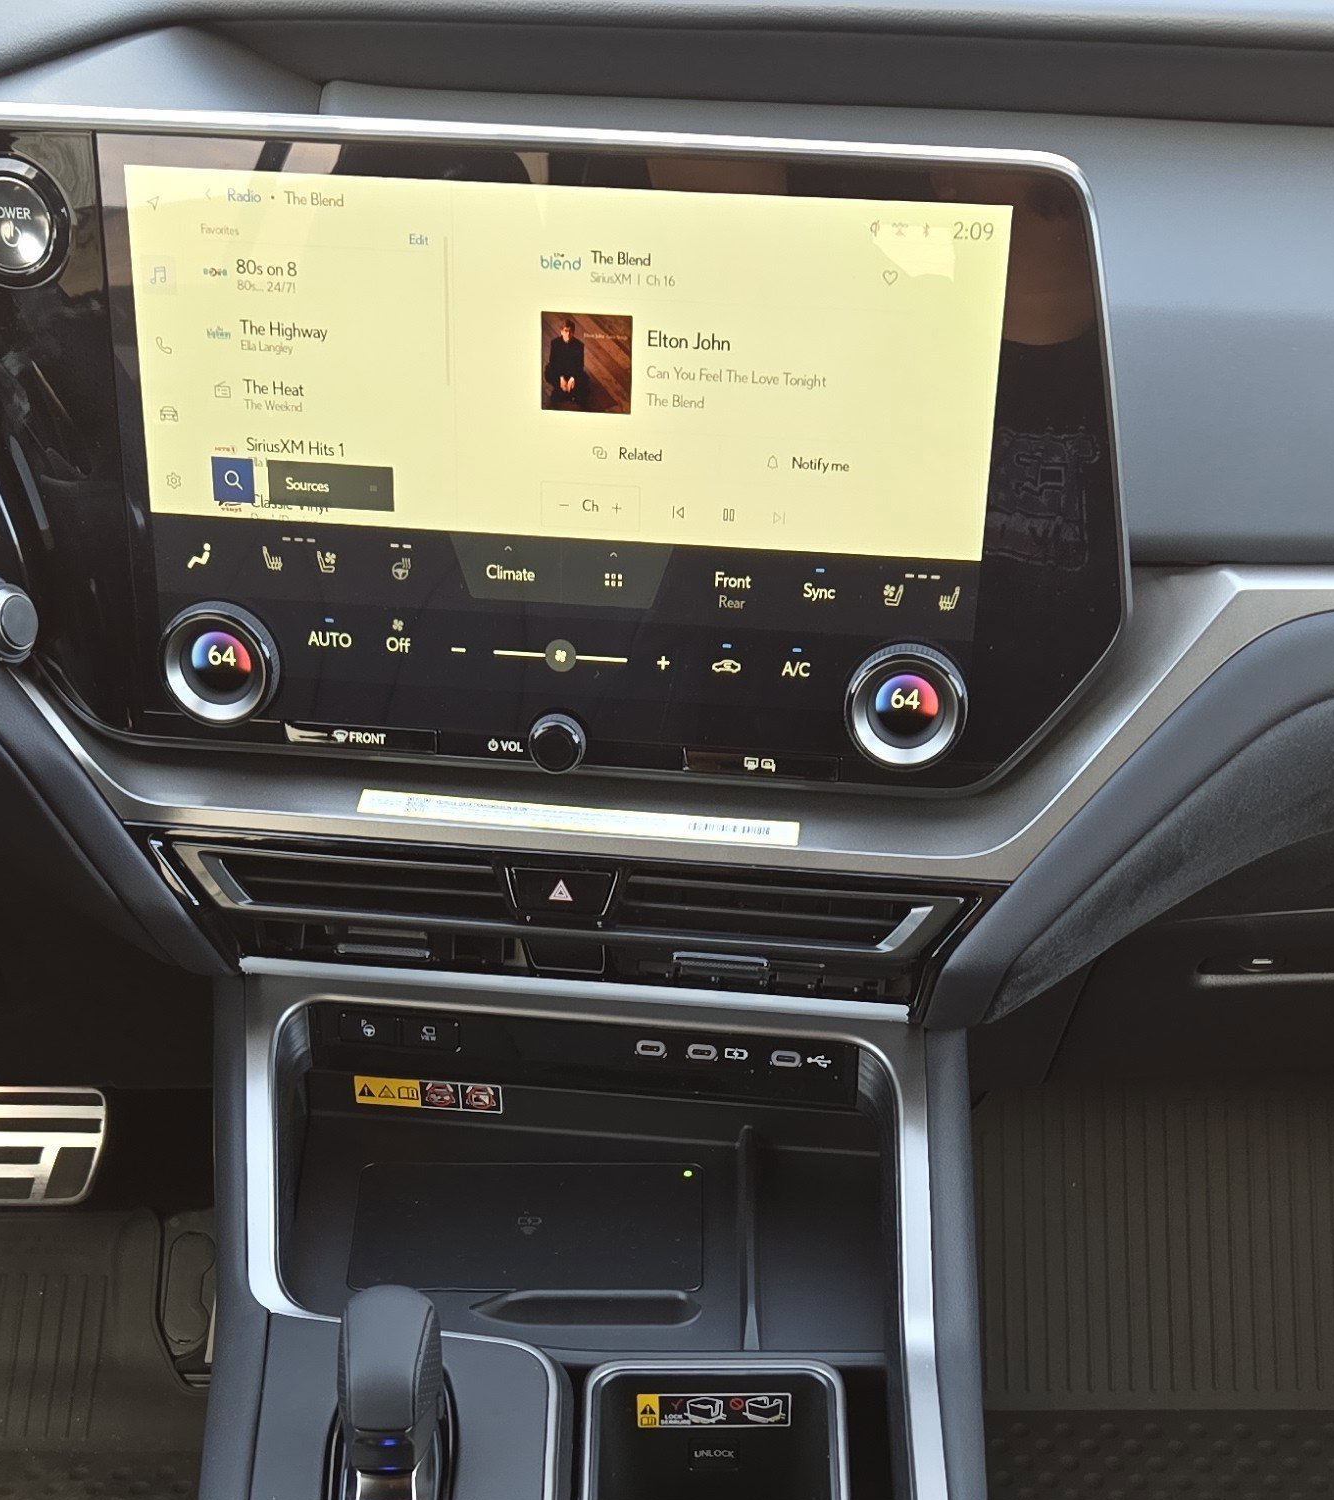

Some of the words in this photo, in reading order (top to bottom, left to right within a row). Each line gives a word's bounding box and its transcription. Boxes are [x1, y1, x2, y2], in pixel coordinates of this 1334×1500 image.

[228, 188, 261, 203] Radio
[284, 191, 307, 205] The
[311, 193, 344, 207] Blend
[201, 224, 239, 236] Favorites
[953, 221, 994, 240] 2:09
[409, 234, 429, 246] Edit
[540, 255, 582, 271] blend
[591, 250, 613, 264] The
[618, 252, 651, 266] Blend
[236, 259, 263, 275] 80s
[267, 265, 283, 276] on
[287, 262, 297, 276] 8
[267, 282, 296, 293] 24/7!
[590, 272, 632, 285] SiriusXM
[646, 275, 660, 286] Ch
[664, 275, 675, 287] 16
[240, 320, 265, 335] The
[269, 322, 327, 342] Highway
[241, 340, 256, 351] Ella
[259, 341, 293, 354] Langley
[647, 331, 688, 349] Elton
[692, 332, 730, 351] John
[647, 366, 669, 379] Can
[673, 367, 695, 381] You
[699, 368, 722, 383] Feel
[727, 370, 748, 383] The
[752, 371, 779, 385] Love
[784, 373, 826, 390] Tonight
[243, 379, 268, 394] The
[273, 381, 304, 397] Heat
[245, 399, 262, 410] The
[265, 400, 302, 412] Weeknd
[647, 393, 668, 407] The
[672, 394, 704, 408] Blend
[246, 437, 304, 454] SiriusXM
[309, 441, 334, 457] Hits
[339, 443, 345, 457] 1
[619, 448, 662, 462] Related
[792, 457, 829, 474] Notify
[832, 463, 849, 472] me
[285, 477, 329, 493] Sources
[582, 499, 599, 513] Ch
[486, 564, 535, 582] Climate
[715, 572, 751, 591] Front
[804, 582, 836, 601] Sync
[719, 595, 746, 610] Rear
[308, 630, 352, 648] AUTO
[386, 637, 411, 654] Off
[208, 644, 236, 668] 64
[782, 661, 811, 678] A/C
[890, 688, 920, 710] 64
[349, 731, 386, 745] FRONT
[501, 740, 523, 753] VOL
[694, 1449, 734, 1458] UNLOCK
